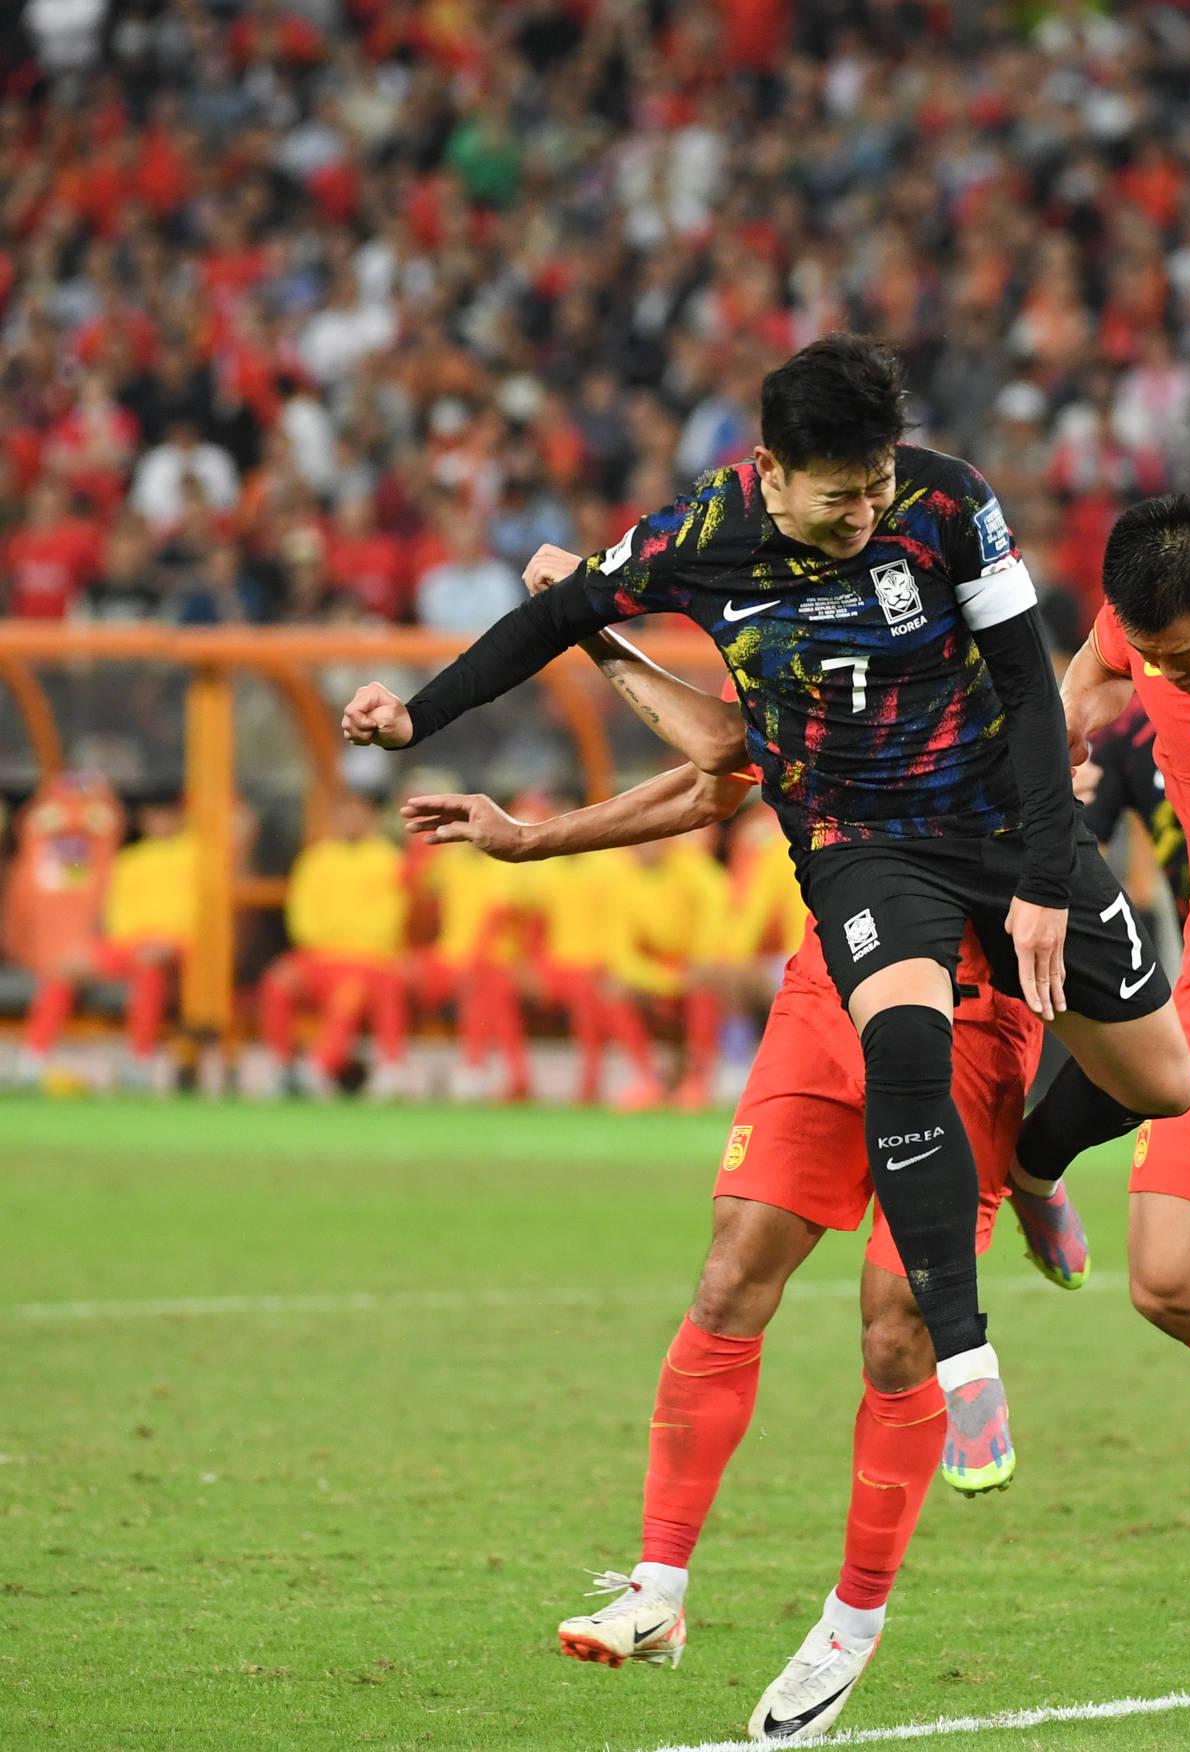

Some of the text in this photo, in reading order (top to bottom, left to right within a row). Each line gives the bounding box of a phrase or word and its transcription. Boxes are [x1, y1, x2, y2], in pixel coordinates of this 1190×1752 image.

[890, 615, 928, 637] KOREA
[821, 655, 870, 714] 7
[1099, 890, 1142, 971] 7
[878, 1126, 945, 1149] KOREA
